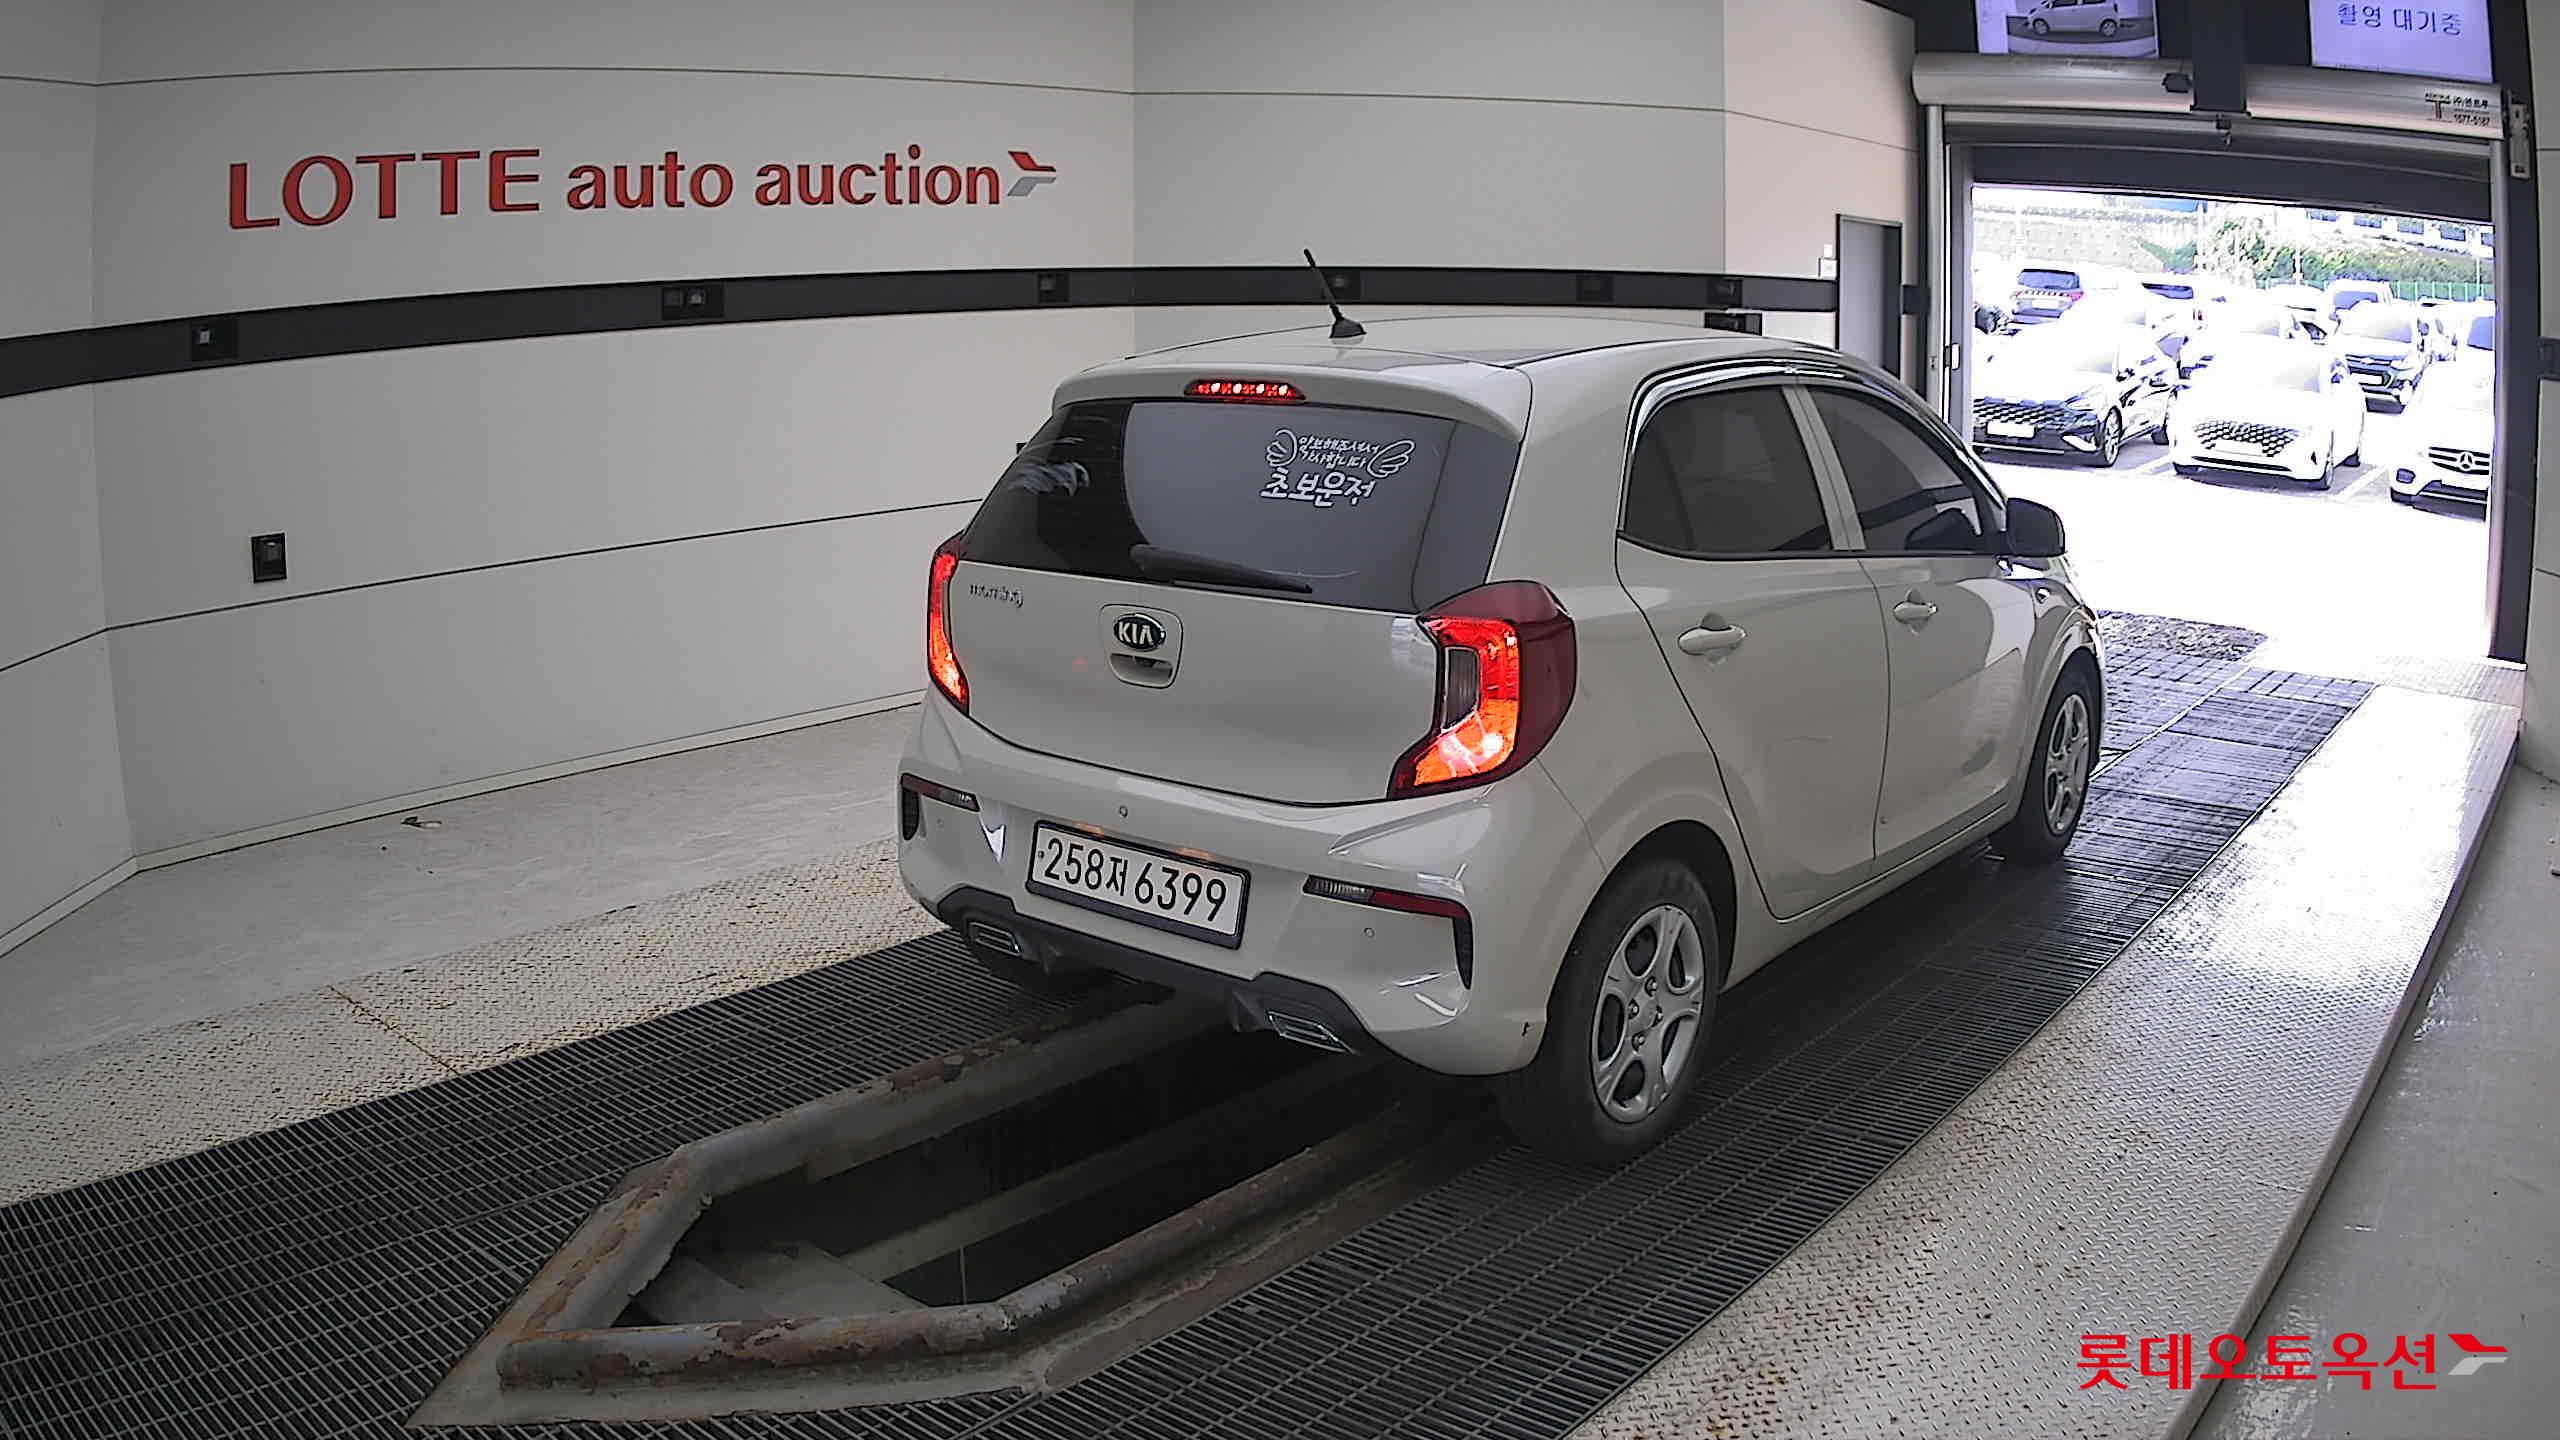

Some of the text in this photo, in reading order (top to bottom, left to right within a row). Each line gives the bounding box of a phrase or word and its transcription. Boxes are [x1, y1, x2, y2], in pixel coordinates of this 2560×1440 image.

[2338, 3, 2464, 36] 촬영 대기중
[229, 145, 1001, 230] LOTTE auto auction
[1261, 467, 1376, 507] 초보운전
[1118, 621, 1154, 645] KIA
